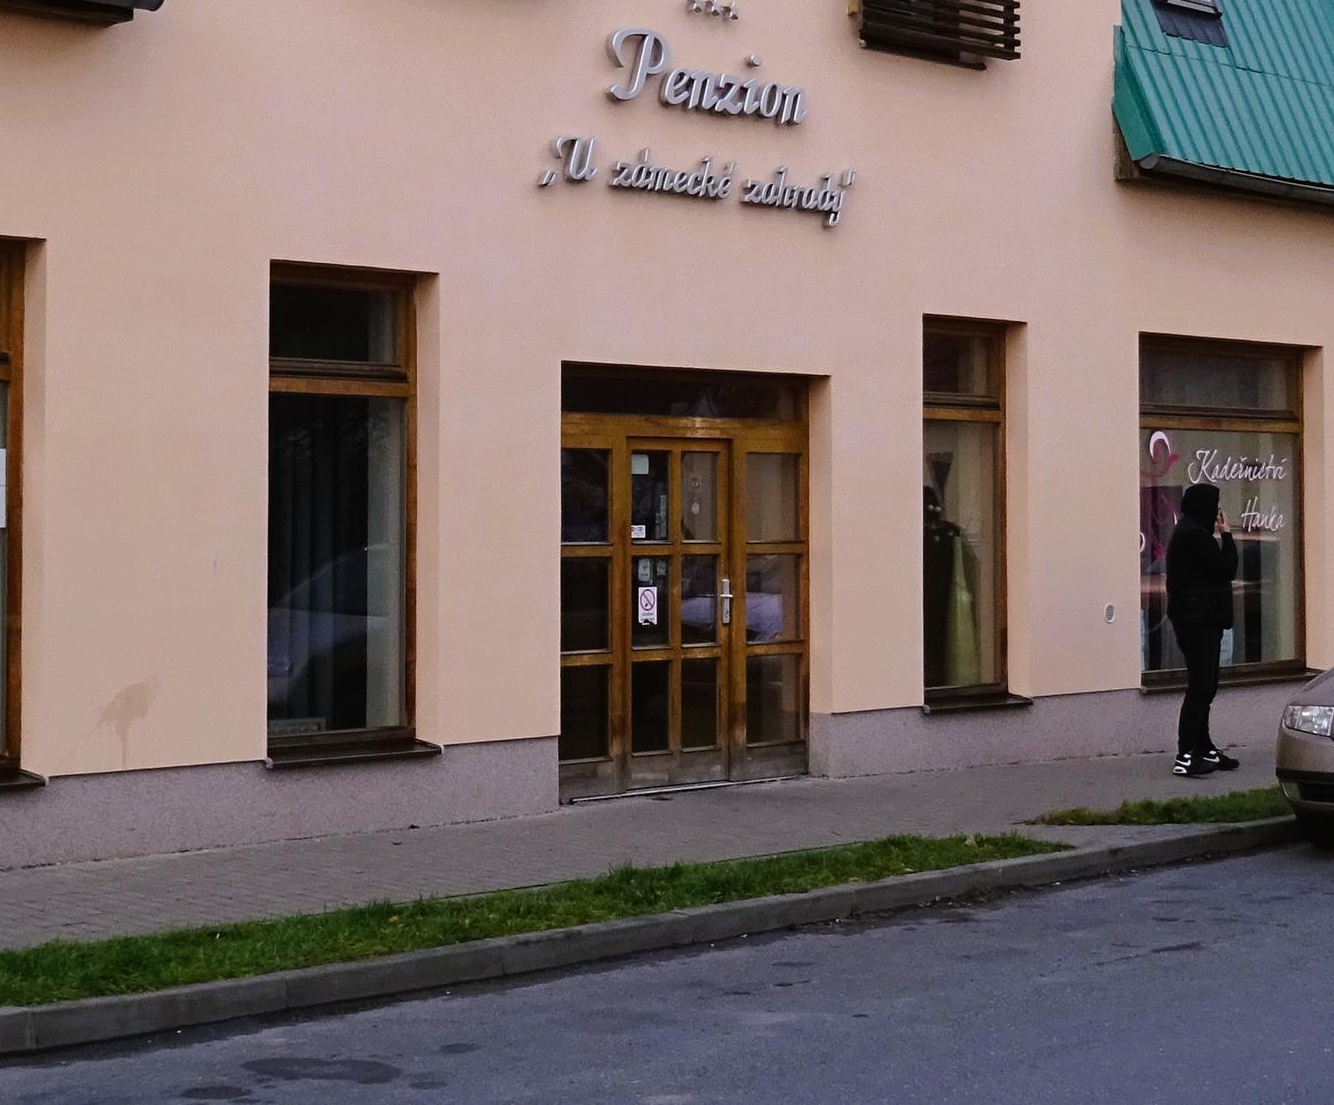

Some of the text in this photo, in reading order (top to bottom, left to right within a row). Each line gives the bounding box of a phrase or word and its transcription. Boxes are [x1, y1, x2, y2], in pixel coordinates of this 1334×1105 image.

[606, 27, 807, 125] Penzion
[610, 148, 735, 200] zámecké
[1240, 496, 1286, 532] Hanka
